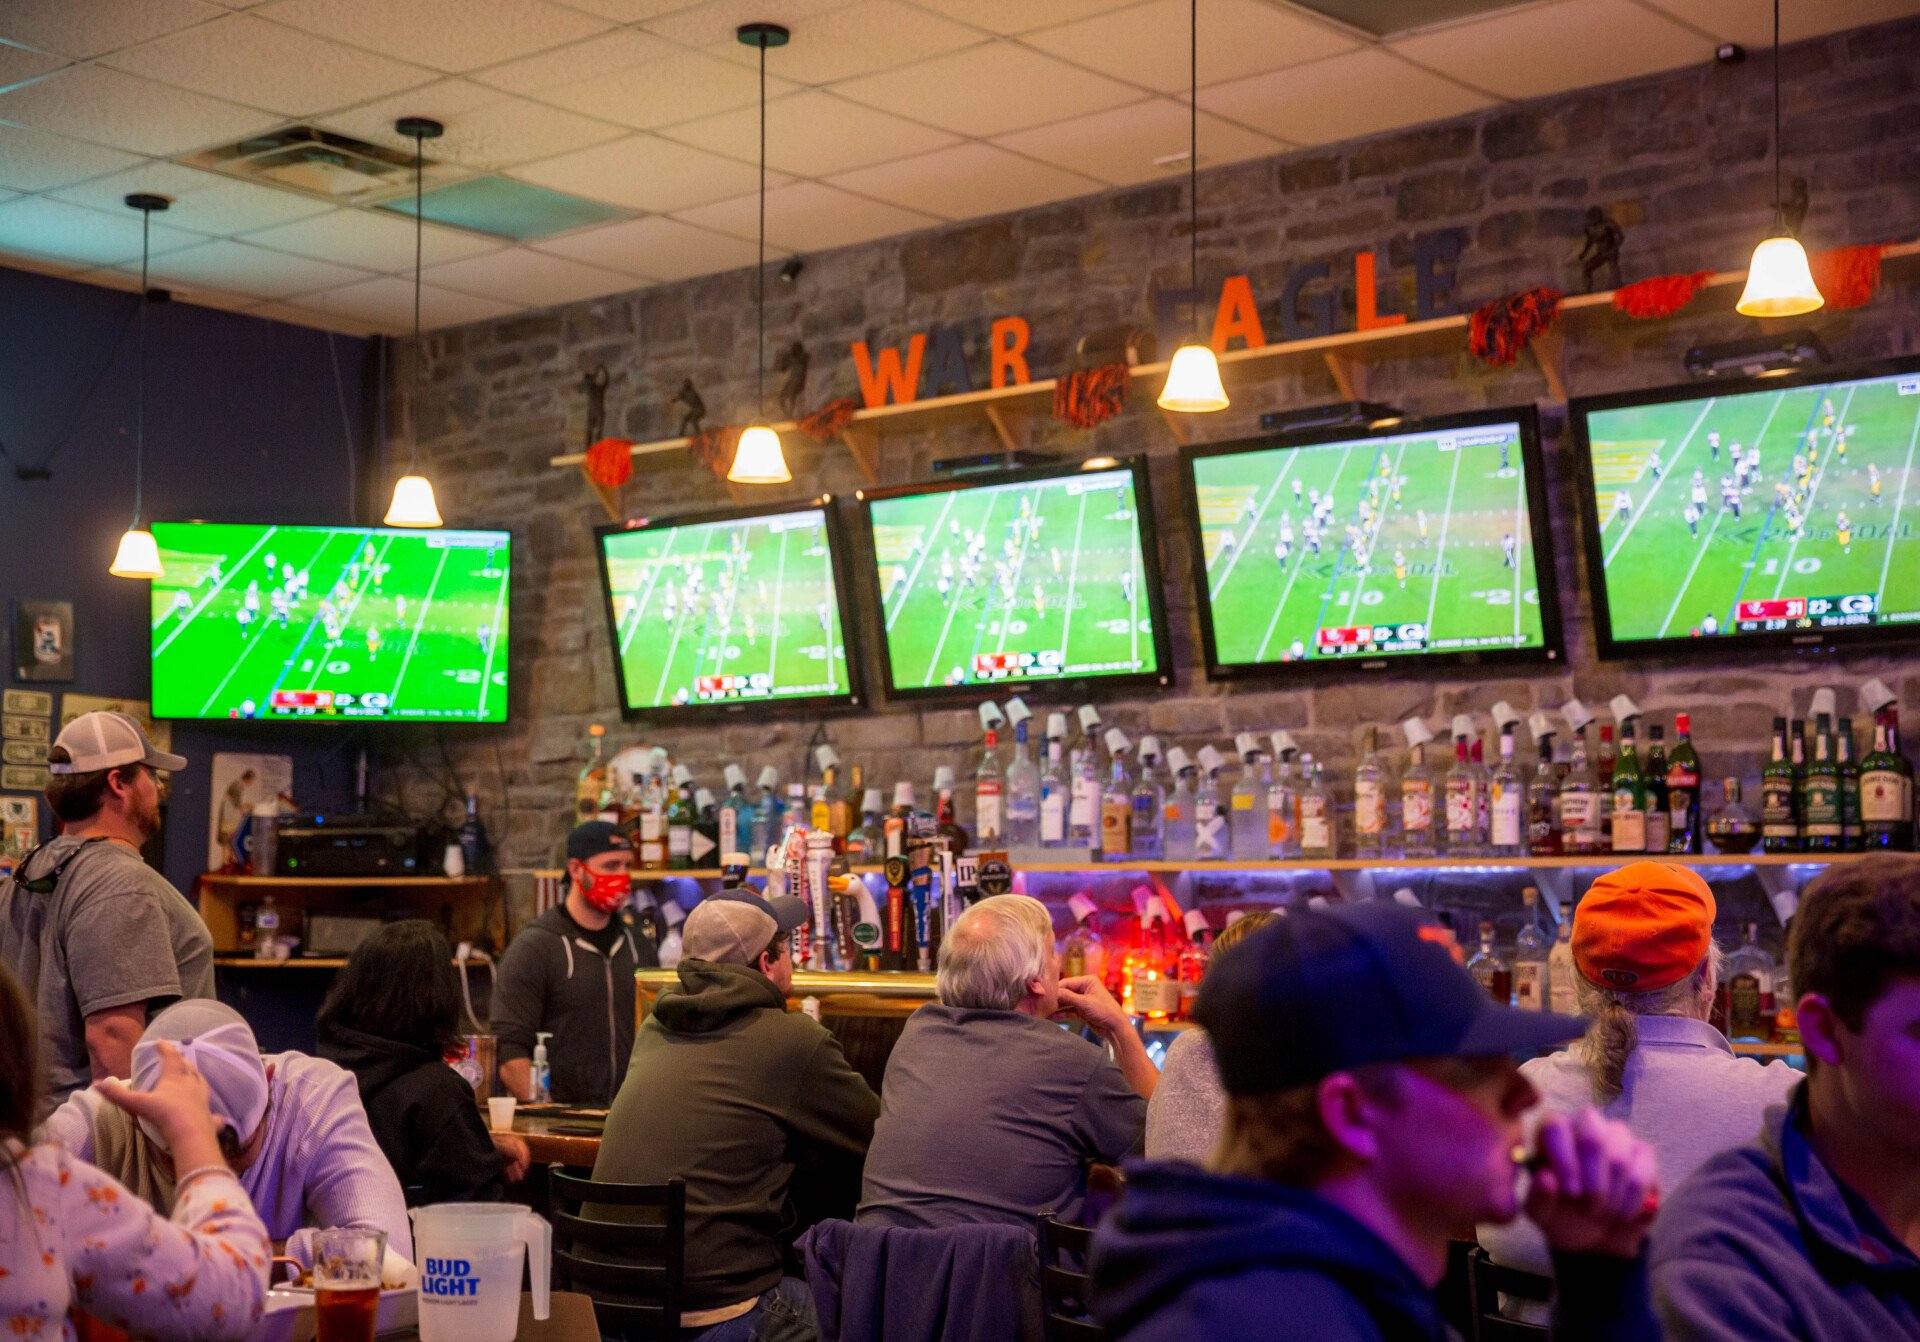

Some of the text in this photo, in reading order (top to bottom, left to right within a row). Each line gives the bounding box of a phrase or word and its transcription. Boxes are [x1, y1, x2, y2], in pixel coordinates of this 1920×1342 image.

[851, 237, 1464, 409] WAR EAGLE
[425, 1257, 471, 1277] BUD
[421, 1275, 480, 1296] LIGHT
